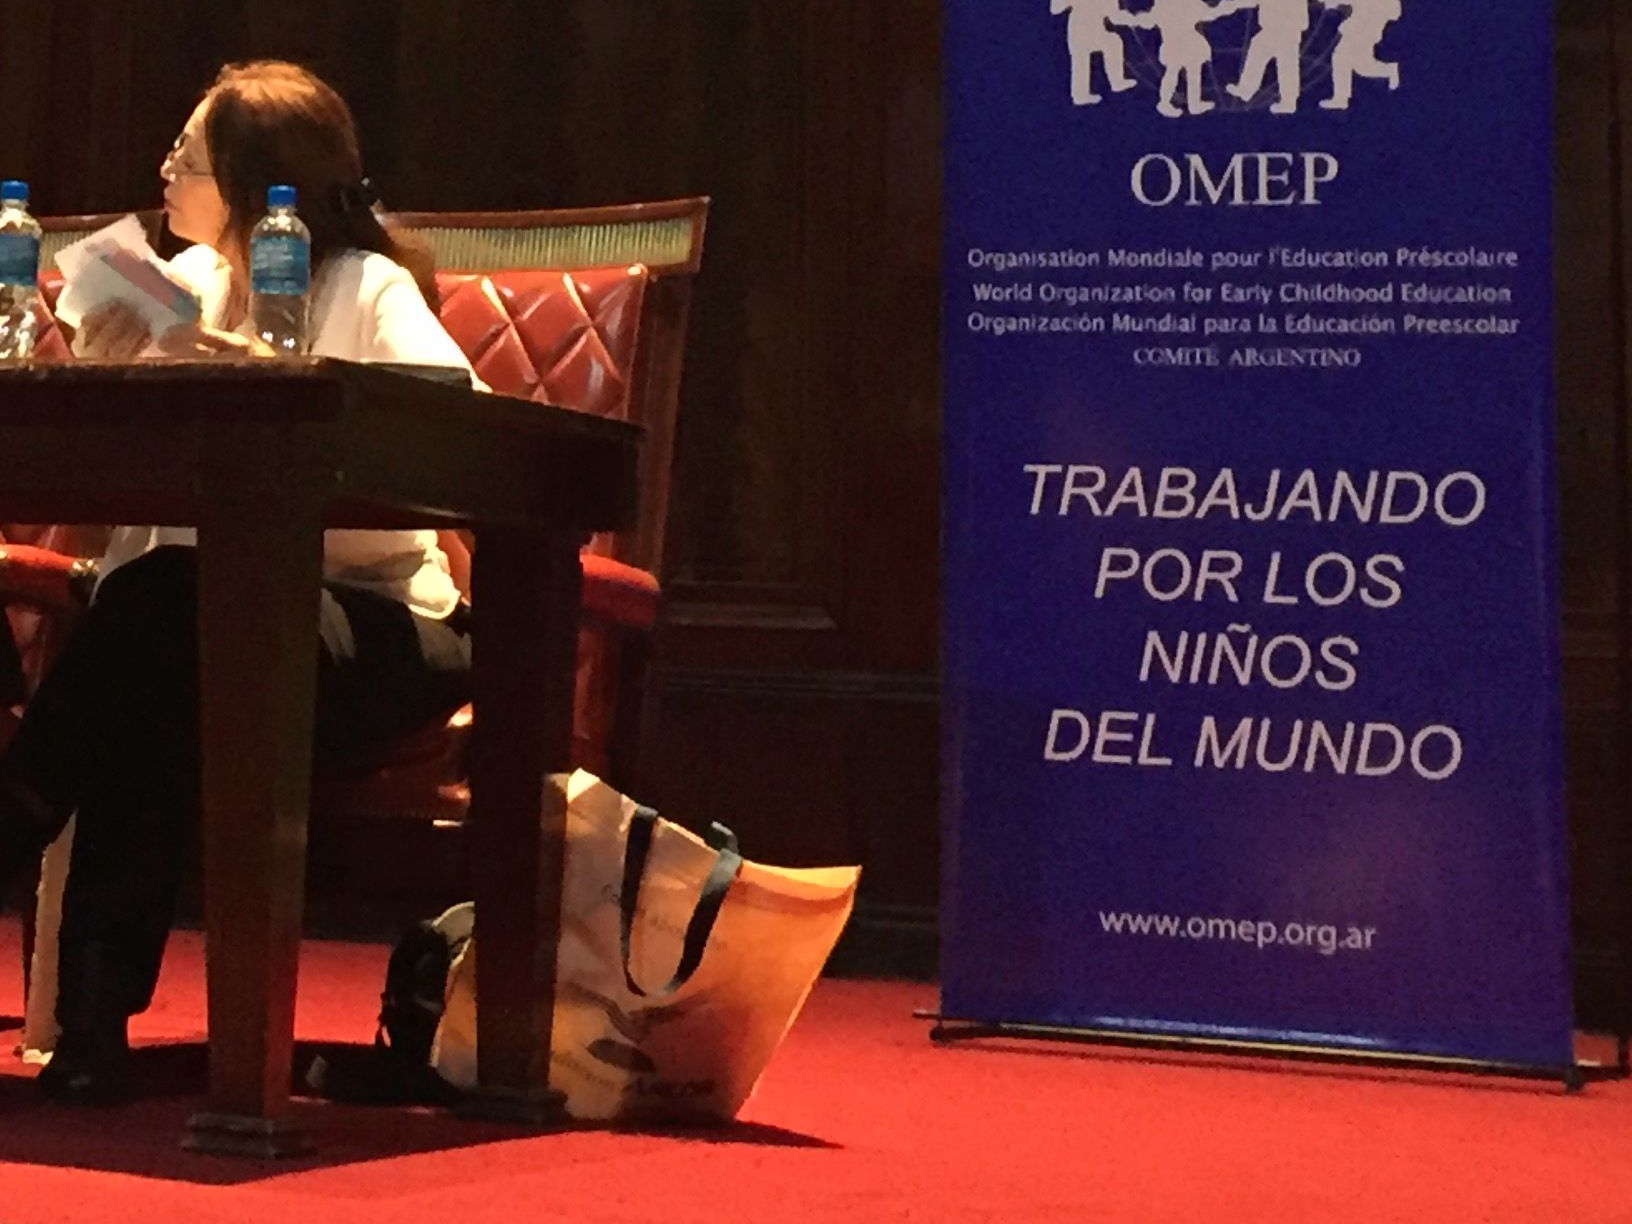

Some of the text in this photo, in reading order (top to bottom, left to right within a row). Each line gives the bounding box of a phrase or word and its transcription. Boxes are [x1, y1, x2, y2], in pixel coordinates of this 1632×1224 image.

[1130, 151, 1340, 207] OMEP
[967, 247, 1100, 272] Organisation
[1107, 247, 1204, 269] Mondiale
[1211, 251, 1263, 272] pour
[972, 281, 1512, 306] World Organization for Early Childhood Education
[967, 312, 1521, 336] Organización Mundial para la Educación Preescolar
[1229, 347, 1362, 368] ARGENTINO
[1023, 464, 1487, 527] TRABAJANDO
[1093, 546, 1406, 608] POR LOS
[1138, 623, 1360, 691] NIÑOS
[1043, 709, 1464, 780] DEL MUNDO
[1098, 908, 1377, 955] www.omep.org.ar
